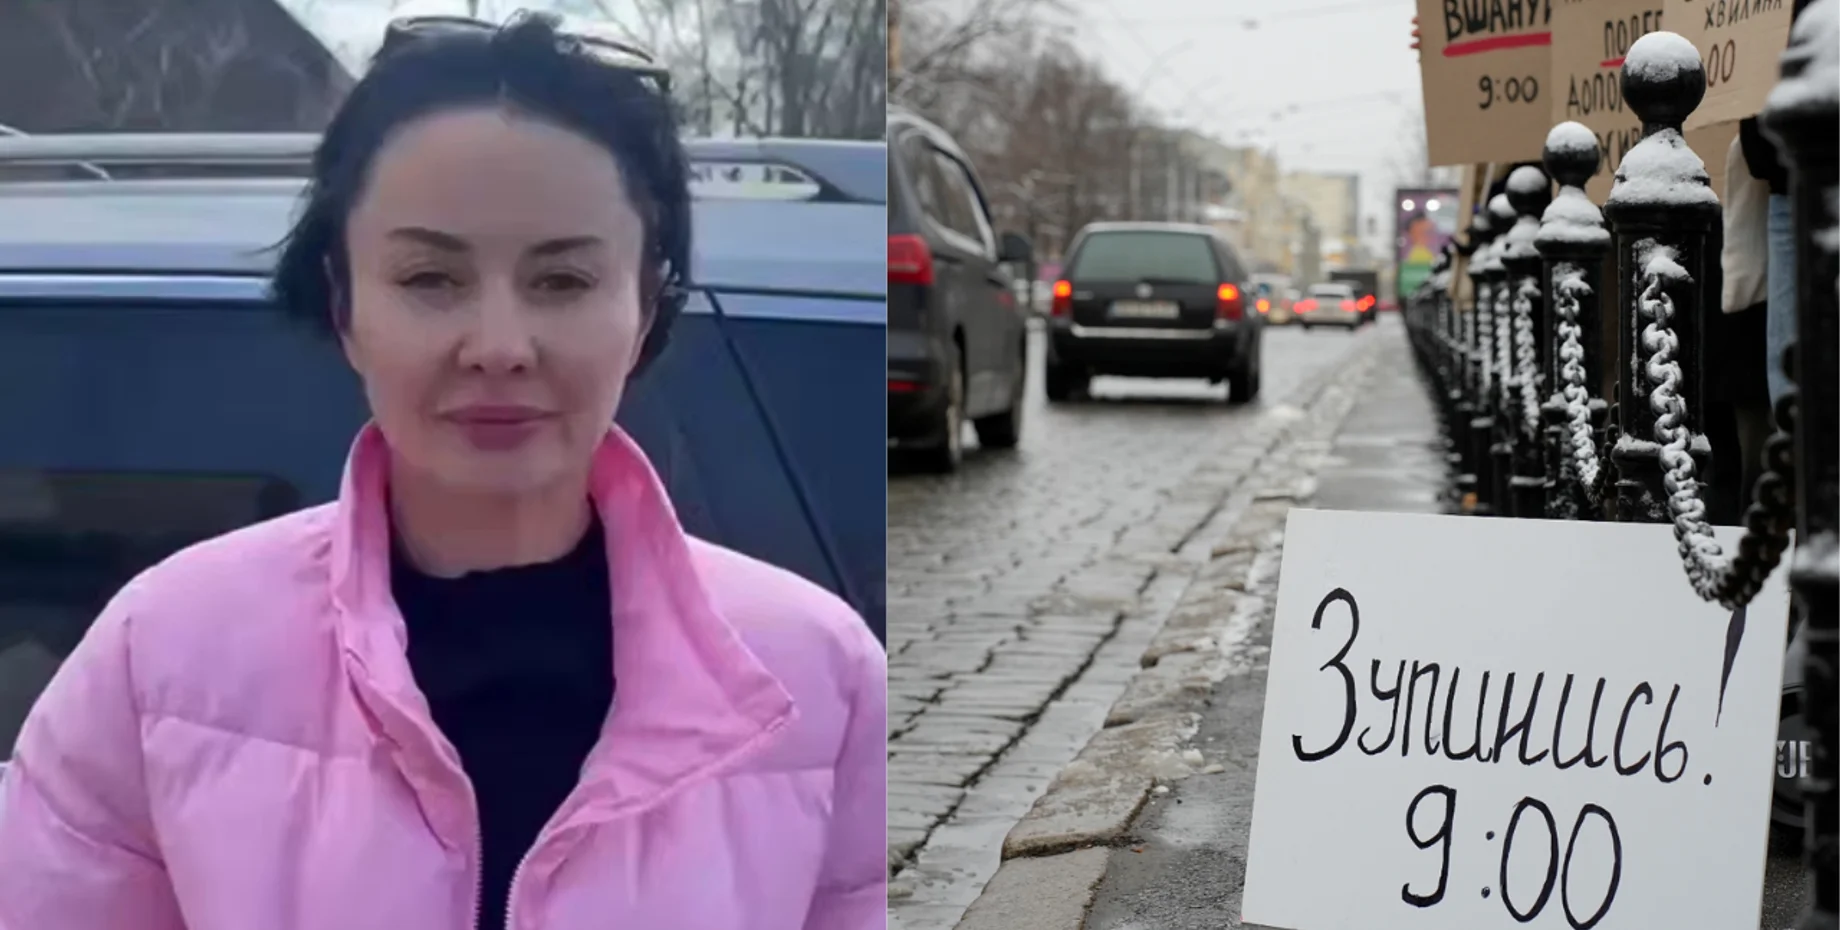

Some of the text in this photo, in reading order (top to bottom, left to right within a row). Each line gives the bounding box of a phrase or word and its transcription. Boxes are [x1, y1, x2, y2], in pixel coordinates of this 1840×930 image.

[1478, 75, 1539, 110] 9:00
[1292, 587, 1747, 785] Зупинись!
[1401, 784, 1622, 930] 9:00
